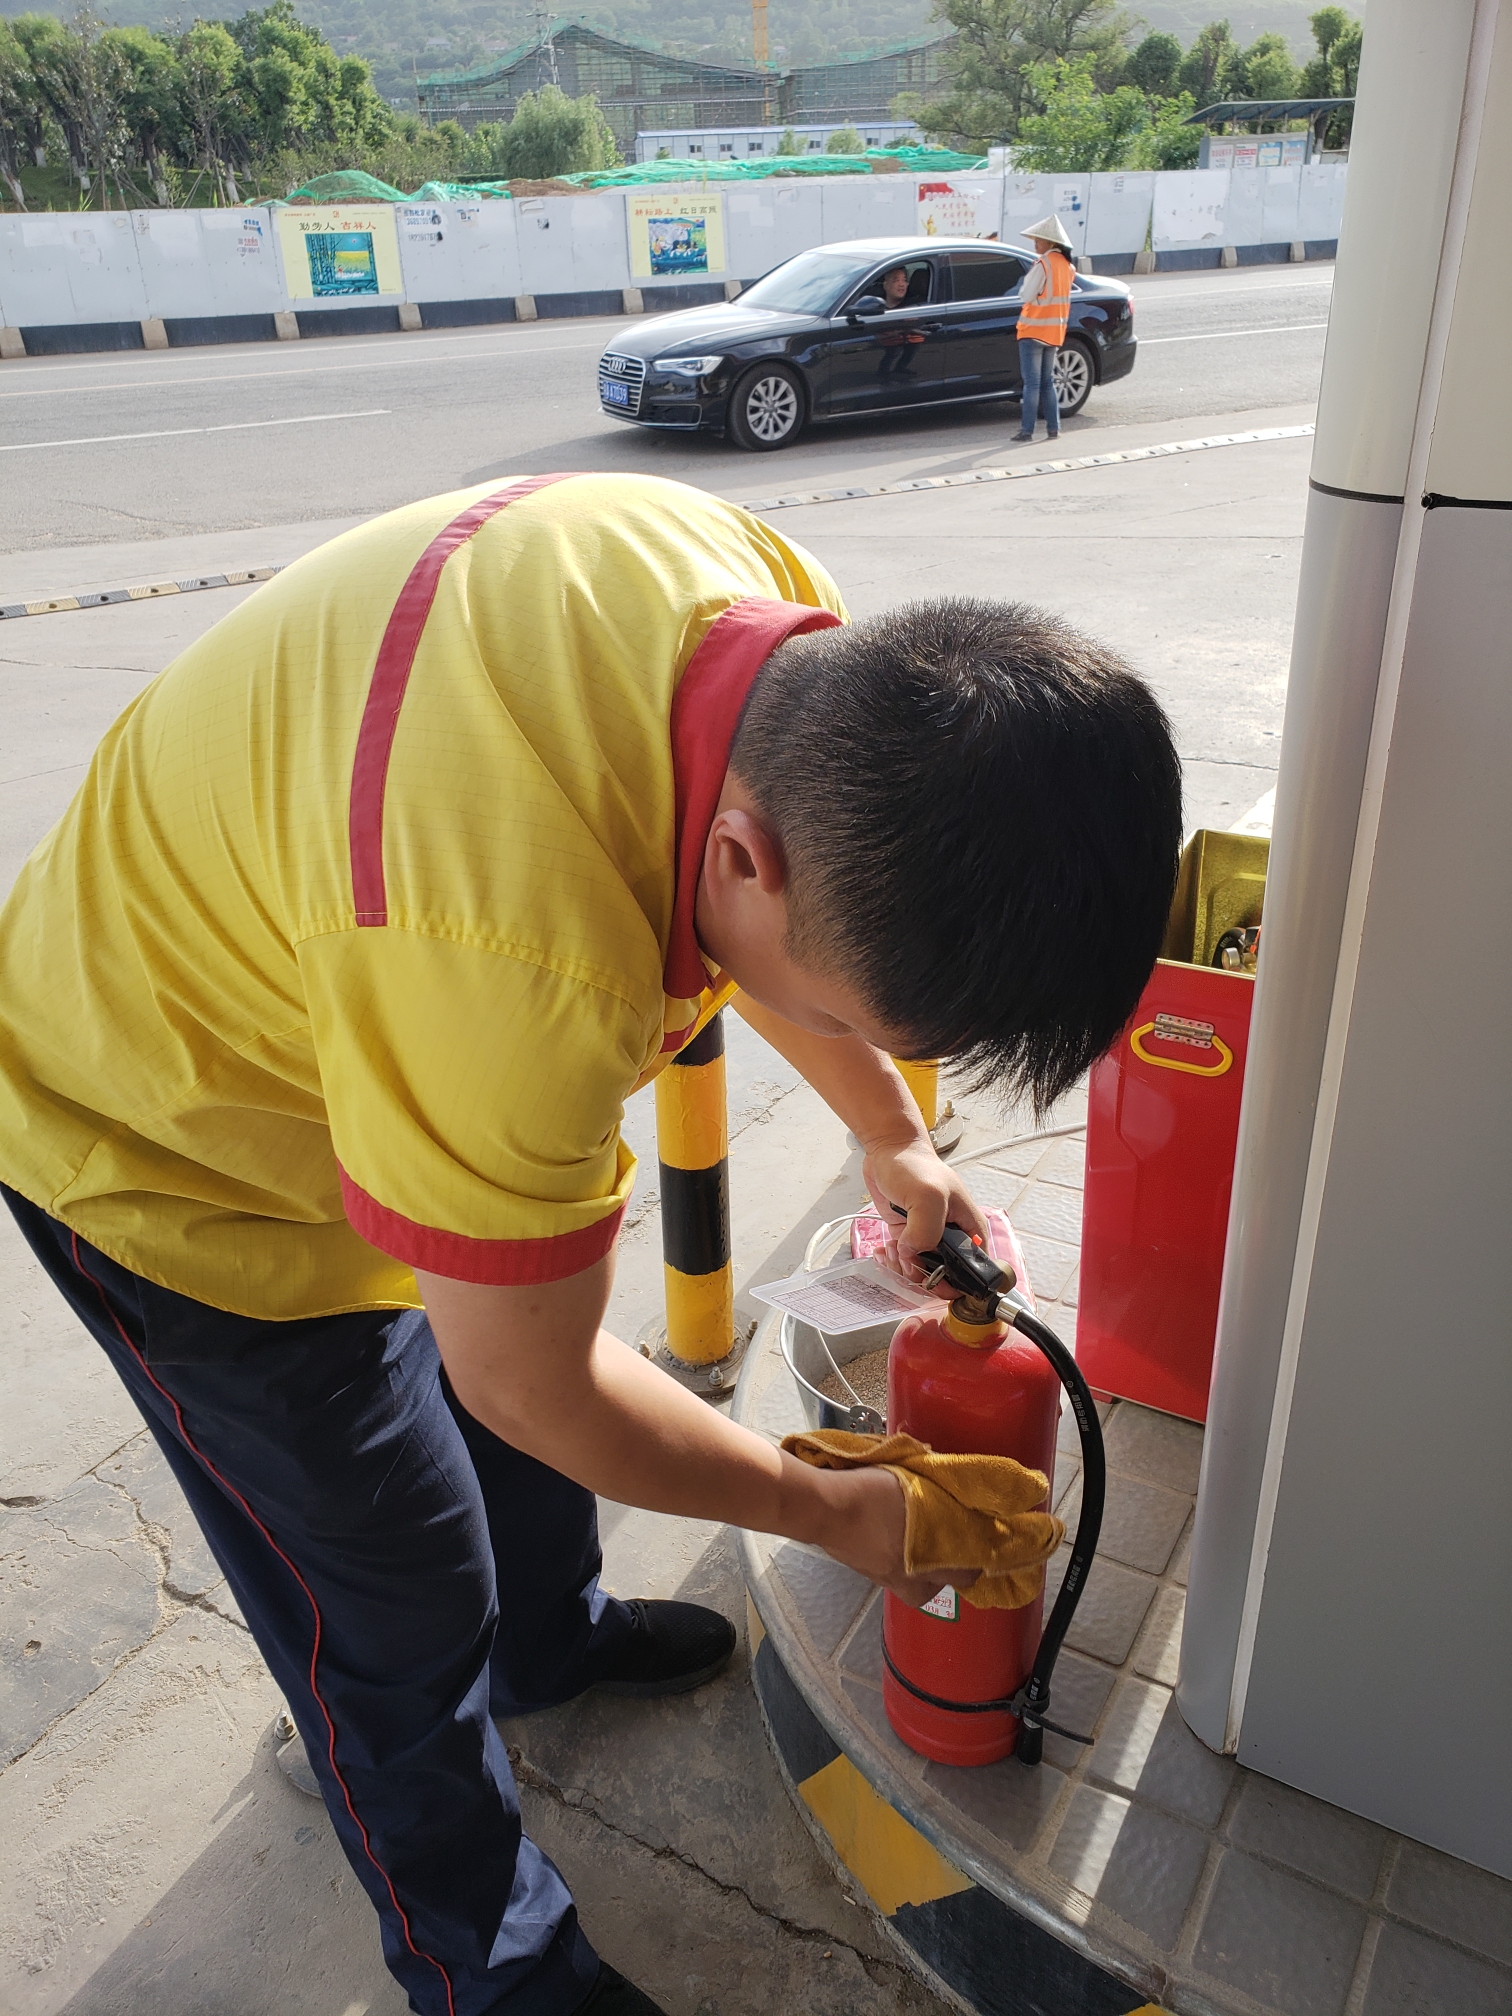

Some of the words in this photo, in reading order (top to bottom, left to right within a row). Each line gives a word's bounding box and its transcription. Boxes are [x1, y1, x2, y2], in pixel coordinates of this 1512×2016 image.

[299, 221, 335, 231] 勤劳人
[340, 221, 377, 231] 吉祥人
